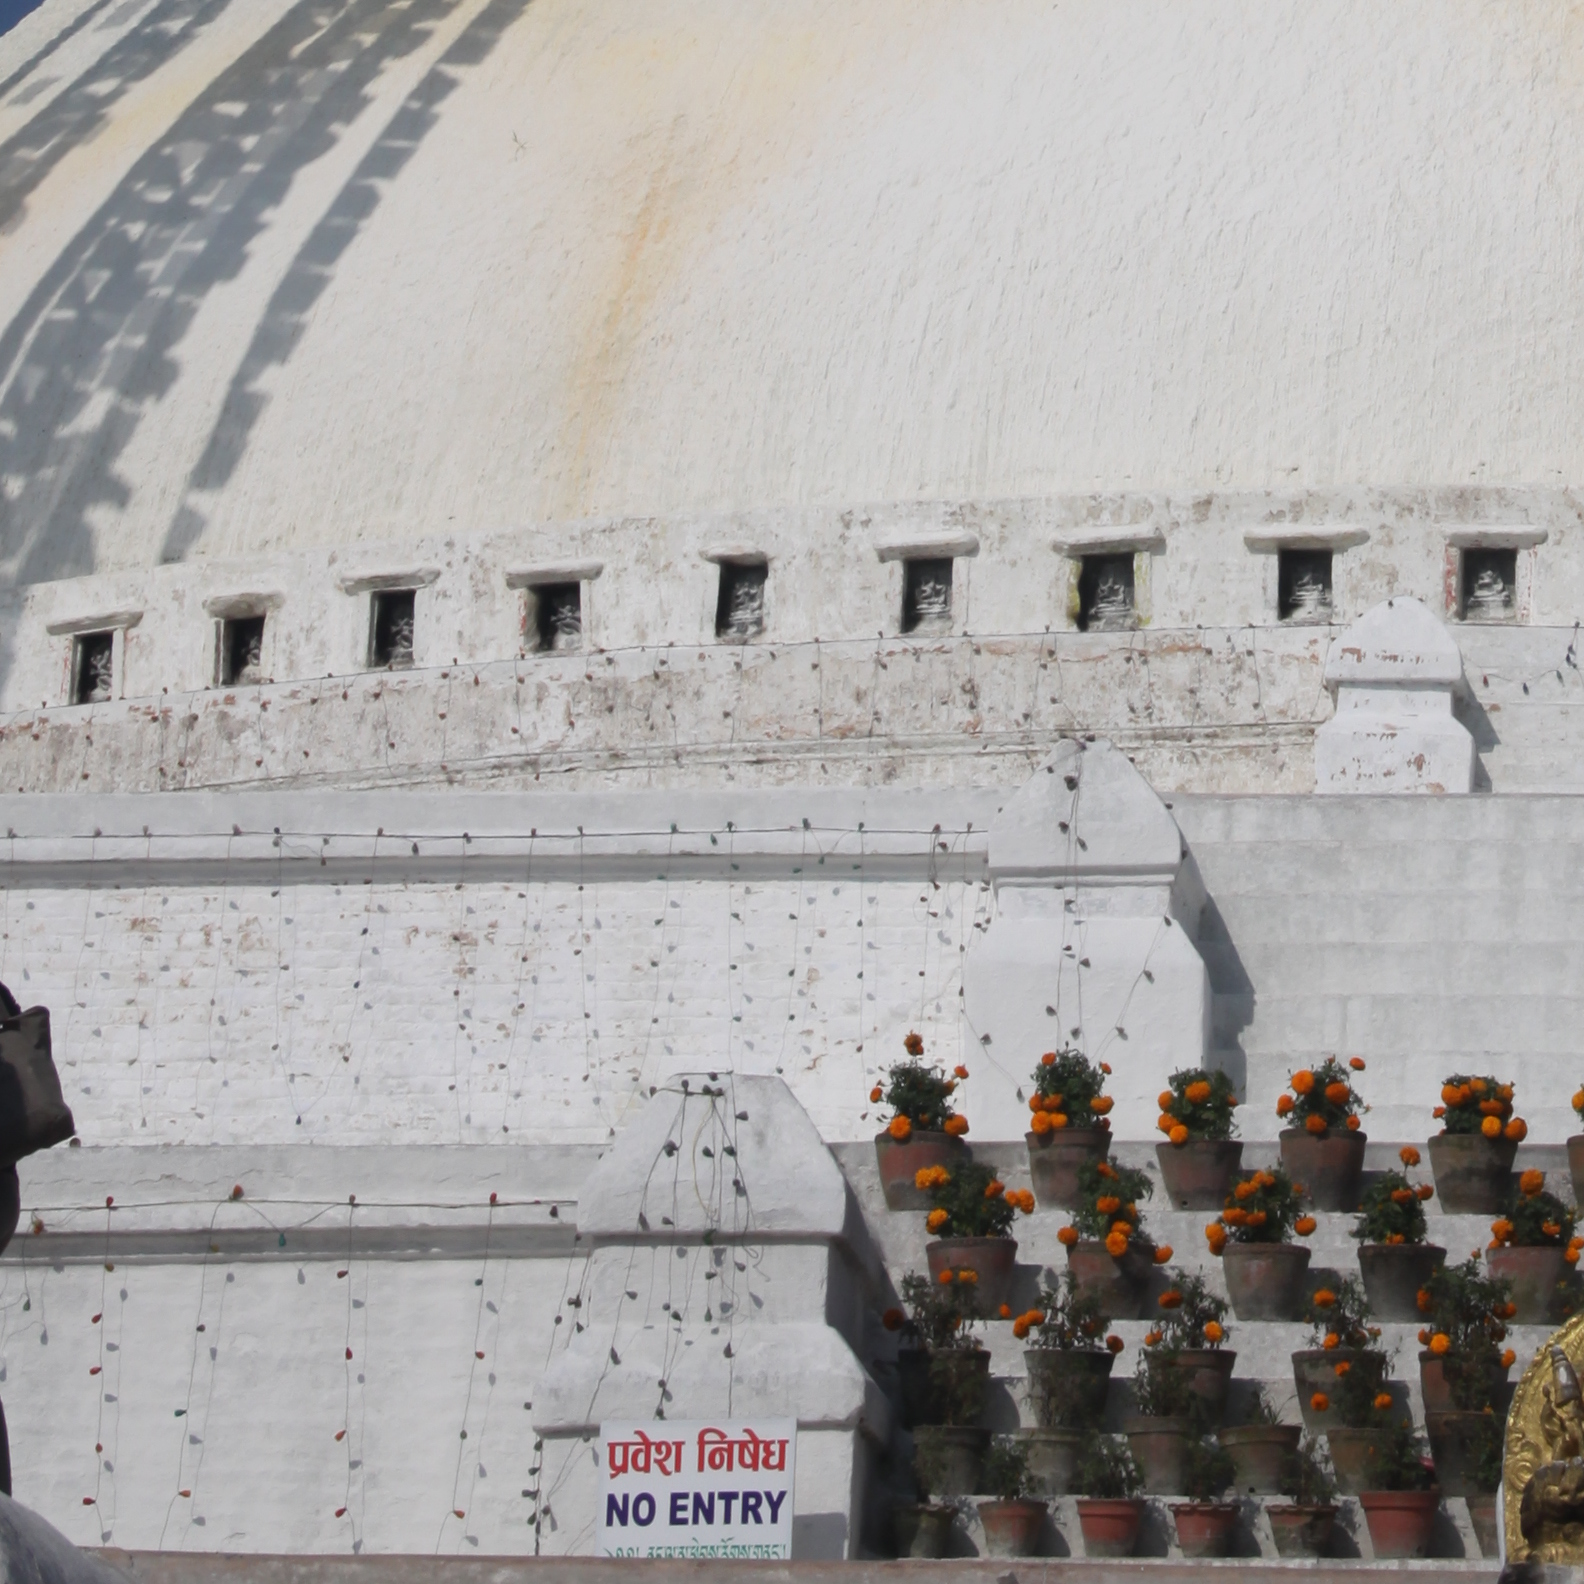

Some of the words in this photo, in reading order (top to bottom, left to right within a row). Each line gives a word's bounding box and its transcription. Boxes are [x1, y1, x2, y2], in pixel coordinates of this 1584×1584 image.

[607, 1430, 685, 1479] प्रवेश
[697, 1427, 789, 1472] निषेध
[606, 1492, 656, 1526] NO
[669, 1490, 787, 1525] ENTRY
